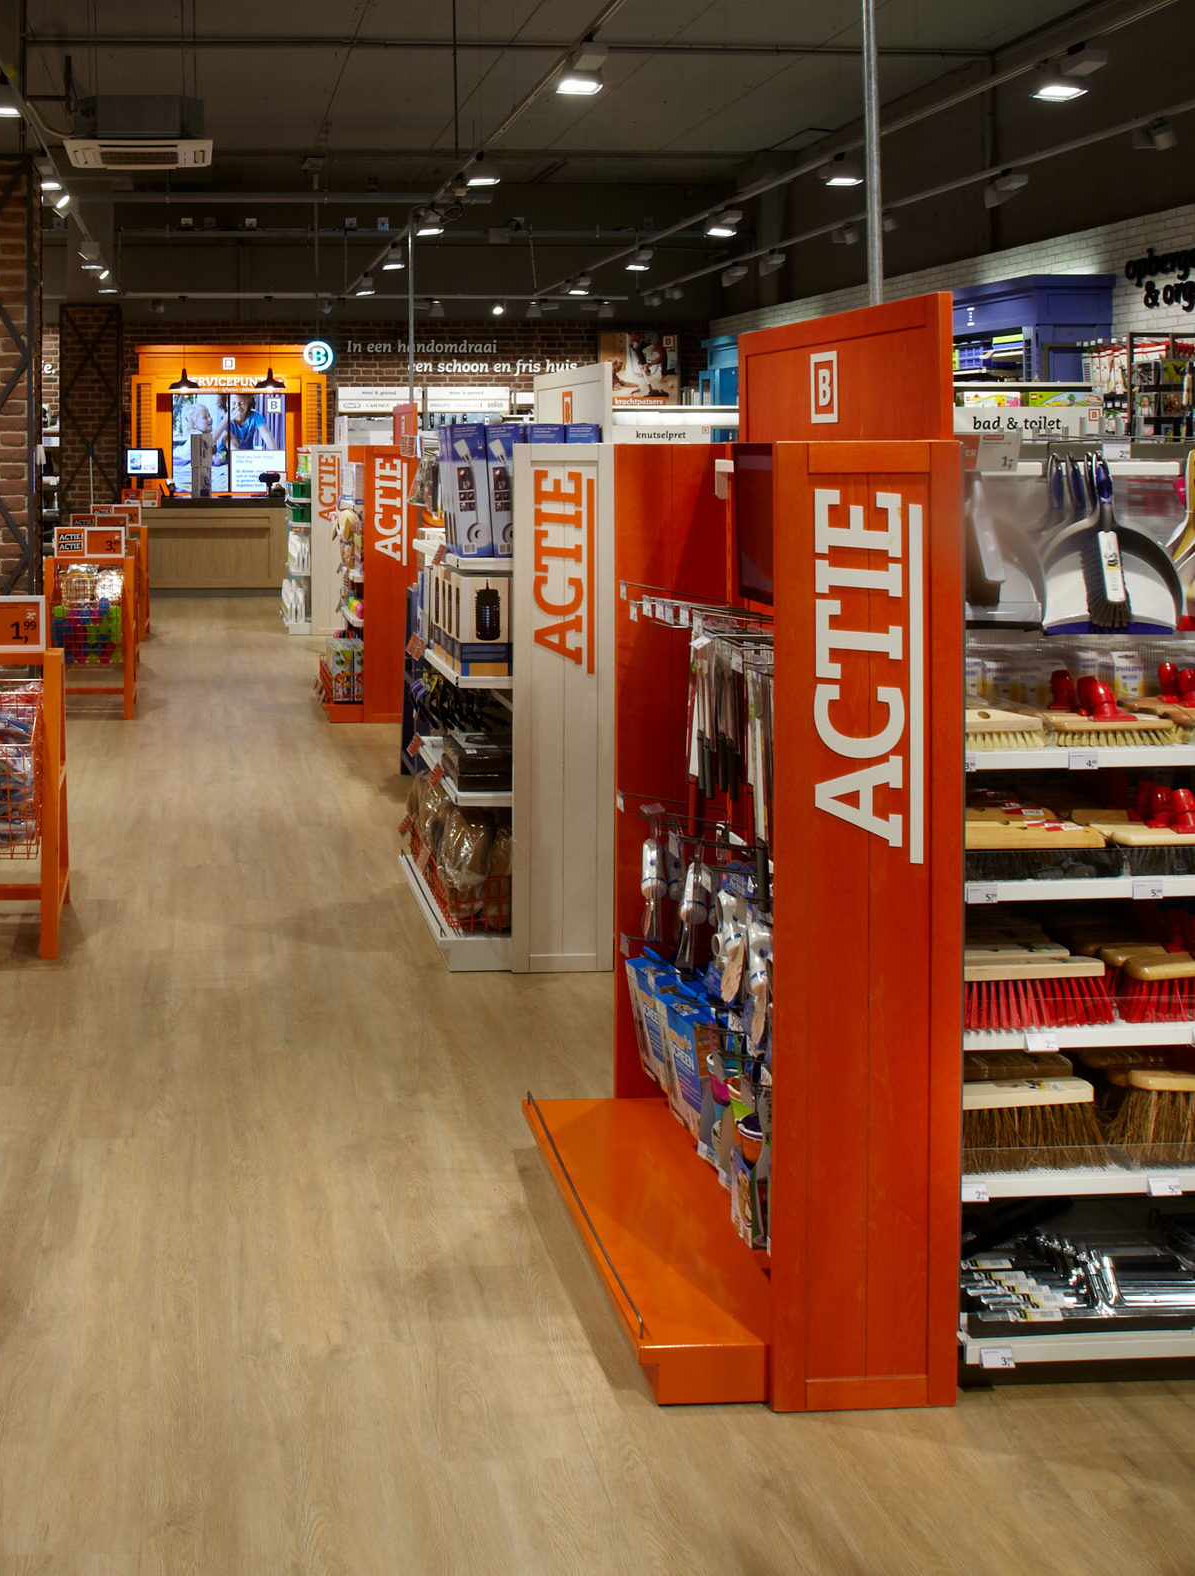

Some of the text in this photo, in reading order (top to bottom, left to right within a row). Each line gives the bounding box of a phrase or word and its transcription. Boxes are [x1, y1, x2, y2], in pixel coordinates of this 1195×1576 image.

[1144, 281, 1160, 309] &
[347, 340, 362, 353] In
[366, 343, 392, 353] een
[437, 359, 489, 373] schoon
[493, 362, 511, 373] en
[514, 359, 541, 376] fris
[545, 359, 578, 373] huis
[818, 368, 831, 407] B
[636, 430, 686, 441] knutselpret
[973, 416, 1062, 430] bad & toilet
[318, 455, 336, 521] ACTIE
[374, 458, 402, 561] ACTIE
[533, 469, 583, 665] ACTIE
[813, 489, 905, 847] ACTIE
